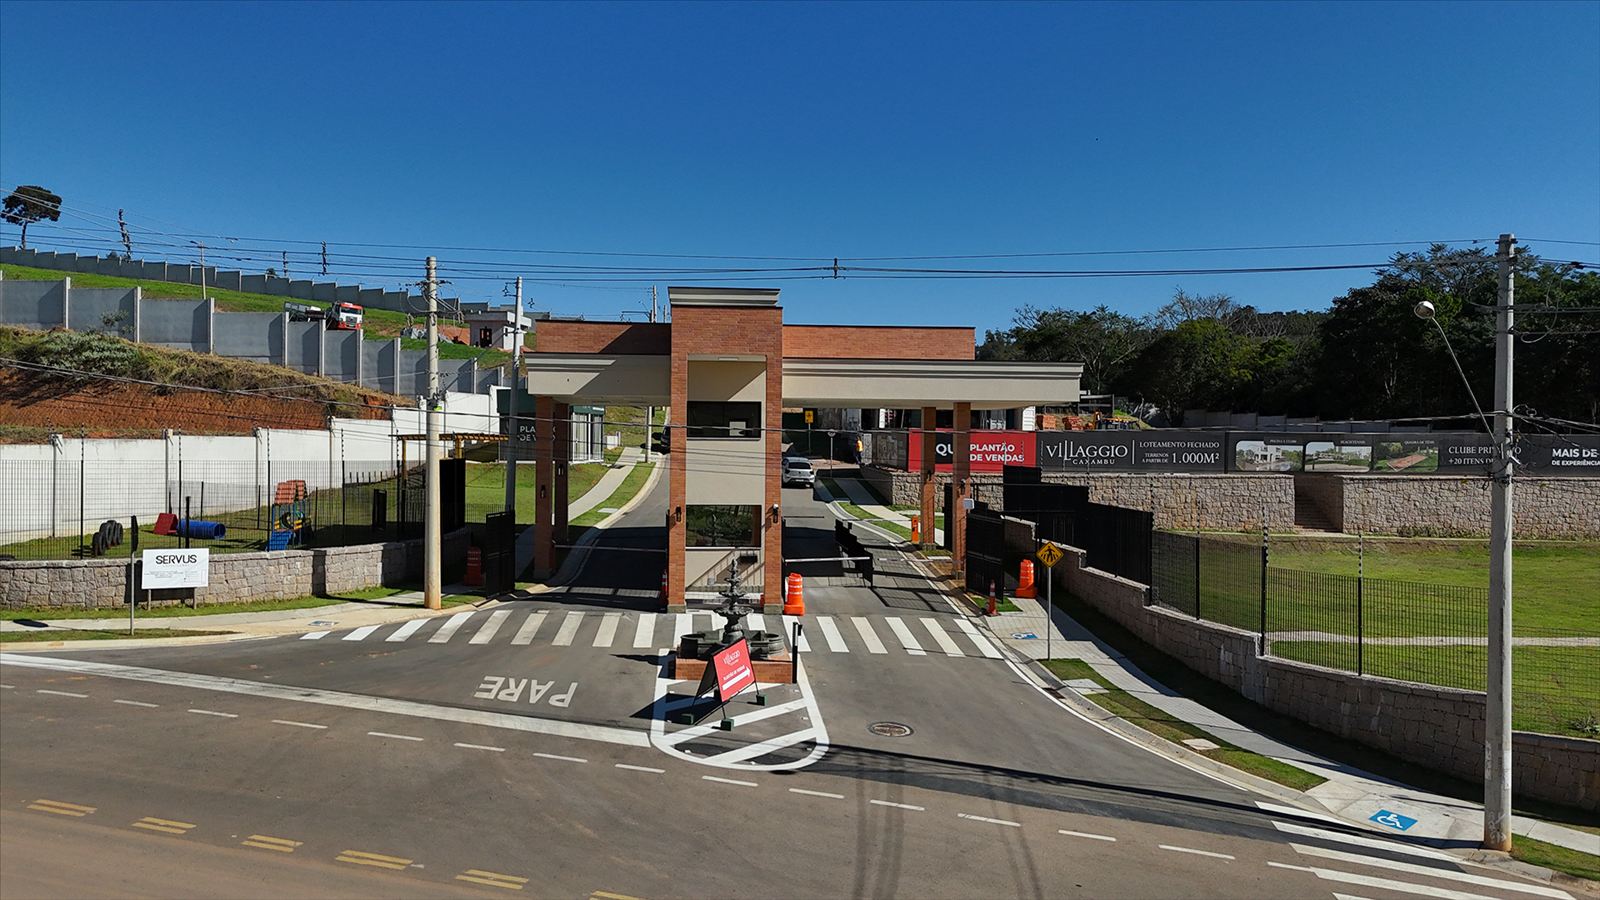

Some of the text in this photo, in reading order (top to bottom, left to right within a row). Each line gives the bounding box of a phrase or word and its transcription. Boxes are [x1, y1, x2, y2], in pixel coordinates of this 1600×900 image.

[969, 442, 1015, 452] PLANTÃO
[1046, 440, 1128, 460] VILLAGGIO
[1448, 446, 1477, 454] CLUBE
[1552, 448, 1598, 458] MAIS DE
[969, 454, 1025, 463] DE VENDAS
[155, 554, 198, 565] SERVUS
[473, 675, 579, 708] PARE
